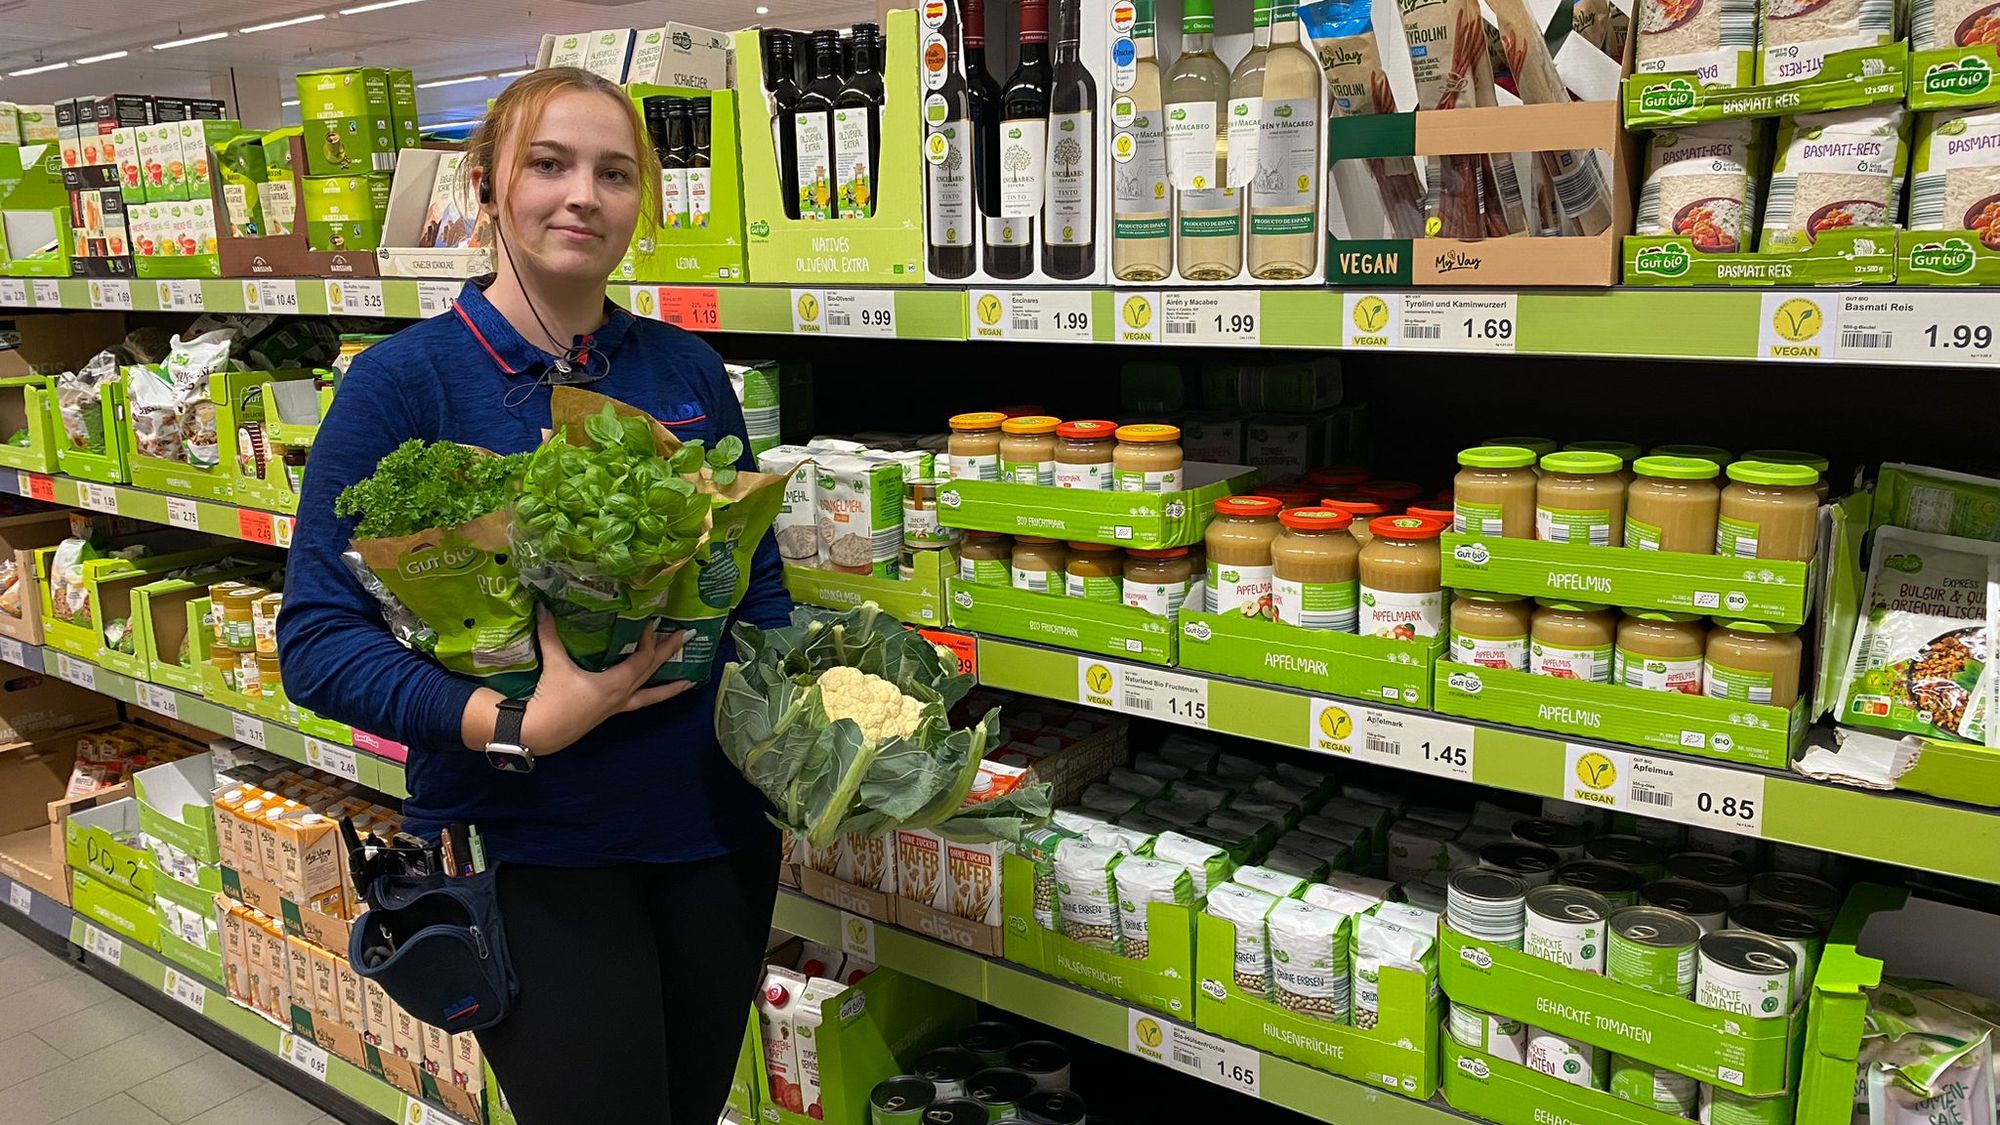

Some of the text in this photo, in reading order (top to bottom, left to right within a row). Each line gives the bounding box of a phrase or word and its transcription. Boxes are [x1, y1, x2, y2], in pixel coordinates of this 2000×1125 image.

[674, 73, 707, 88] SCHWEIZER
[1930, 72, 1983, 91] GUT bio
[1645, 91, 1688, 106] GUT bio
[1724, 94, 1800, 114] BASMATI REIS
[1281, 120, 1314, 128] MACABEO
[1663, 144, 1732, 165] BASMATI-REIS
[1804, 142, 1881, 159] BASMATI-REIS
[812, 237, 850, 252] NATIVES
[676, 258, 700, 270] LEINÖL
[796, 256, 870, 273] OLIVENÖL EXTRA
[1340, 253, 1398, 274] VEGAN
[1435, 254, 1482, 270] My Vay
[1640, 254, 1683, 268] GUT bio
[1915, 250, 1965, 266] GUT bio
[1718, 264, 1792, 278] BASMATI REIS
[118, 292, 129, 302] 1.69
[188, 294, 202, 304] 1.25
[276, 294, 296, 305] 10.45
[364, 296, 381, 307] 5.25
[1166, 298, 1182, 306] Airén
[1405, 301, 1432, 309] Tyrolini
[1845, 303, 1914, 312] Basmati Reis
[692, 310, 717, 324] 1.19
[862, 310, 891, 326] 9.99
[1053, 312, 1088, 330] 1.99
[1214, 314, 1254, 333] 1.99
[800, 324, 820, 332] VEGAN
[978, 328, 1002, 336] VEGAN
[1464, 318, 1512, 338] 1.69
[1924, 324, 1992, 348] 1.99
[1354, 337, 1387, 345] VEGAN
[1773, 347, 1818, 356] VEGAN
[183, 512, 196, 523] 2.75
[406, 548, 476, 575] GUT bio
[1457, 550, 1487, 561] GUT bio
[1236, 582, 1272, 595] APFELMA
[1547, 572, 1612, 593] APFELMUS
[1943, 578, 1979, 589] EXPRESS
[1900, 584, 1962, 604] BULGUR &
[1372, 610, 1422, 622] APFELMARK
[1030, 621, 1079, 638] BIO FRUCHTMARK
[1265, 652, 1328, 676] APFELMARK
[1125, 675, 1152, 685] Naturland
[1165, 682, 1199, 694] Fruchtmark
[1451, 679, 1479, 690] GUT bio
[1087, 695, 1113, 706] VEGAN
[1168, 698, 1206, 719] 1.15
[1366, 716, 1404, 728] Apfelmark
[1538, 704, 1600, 727] APFELMUS
[250, 729, 264, 742] 3.75
[1320, 741, 1350, 753] VEGAN
[1421, 742, 1466, 766] 1.45
[340, 761, 355, 774] 2.49
[1633, 764, 1674, 776] Apfelmus
[1576, 790, 1613, 804] VEGAN
[1698, 792, 1754, 820] 0.85
[916, 836, 938, 850] ZUCKER
[900, 844, 939, 869] HAFER
[950, 848, 990, 866] OHNE ZUCKER
[949, 860, 992, 882] HAFER
[823, 884, 870, 914] alpro
[920, 915, 973, 946] alpro
[1527, 942, 1573, 964] TOMATEN
[1058, 954, 1123, 988] HÜLSENFRÜCHTE
[1297, 974, 1324, 987] ERBSEN
[1362, 990, 1378, 1002] GRÜN
[1704, 981, 1741, 1000] GEHACKTE
[1700, 989, 1752, 1016] TOMATEN
[1536, 997, 1652, 1045] GEHACKTE TOMATEN
[1173, 1031, 1226, 1054] Bio-Hülsenfrüchte
[1263, 1023, 1344, 1060] HÜLSENFRÜCHTE
[1136, 1045, 1162, 1060] VEGAN
[310, 1058, 325, 1074] 0.95
[1217, 1060, 1254, 1085] 1.65
